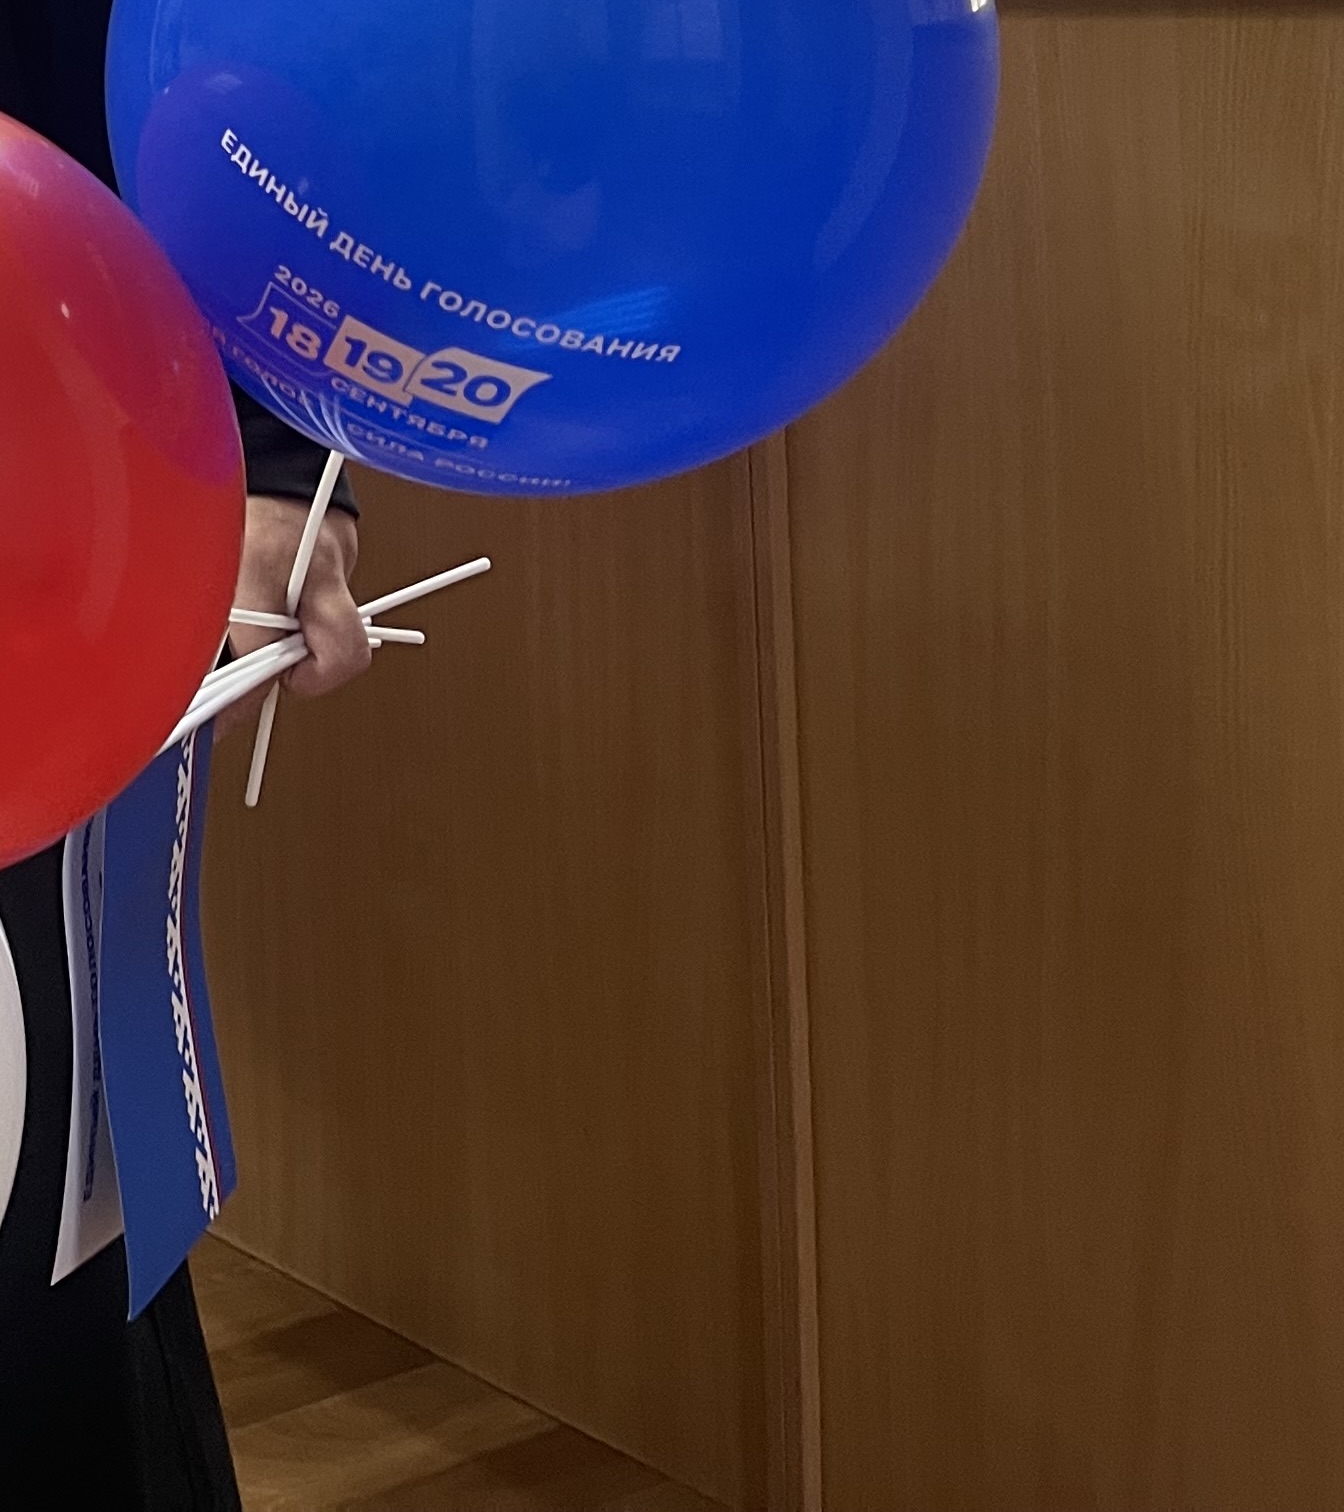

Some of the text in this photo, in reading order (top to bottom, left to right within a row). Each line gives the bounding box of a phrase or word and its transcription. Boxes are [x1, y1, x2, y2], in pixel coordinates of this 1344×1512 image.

[220, 128, 681, 365] ЕДИНЫЙ ДЕНЬ ГОЛОСОВАНИЯ
[274, 265, 341, 319] 2026
[269, 306, 322, 362] 18
[342, 333, 405, 384] 19
[420, 360, 513, 408] 20
[331, 377, 489, 449] СЕНТЯБРЯ
